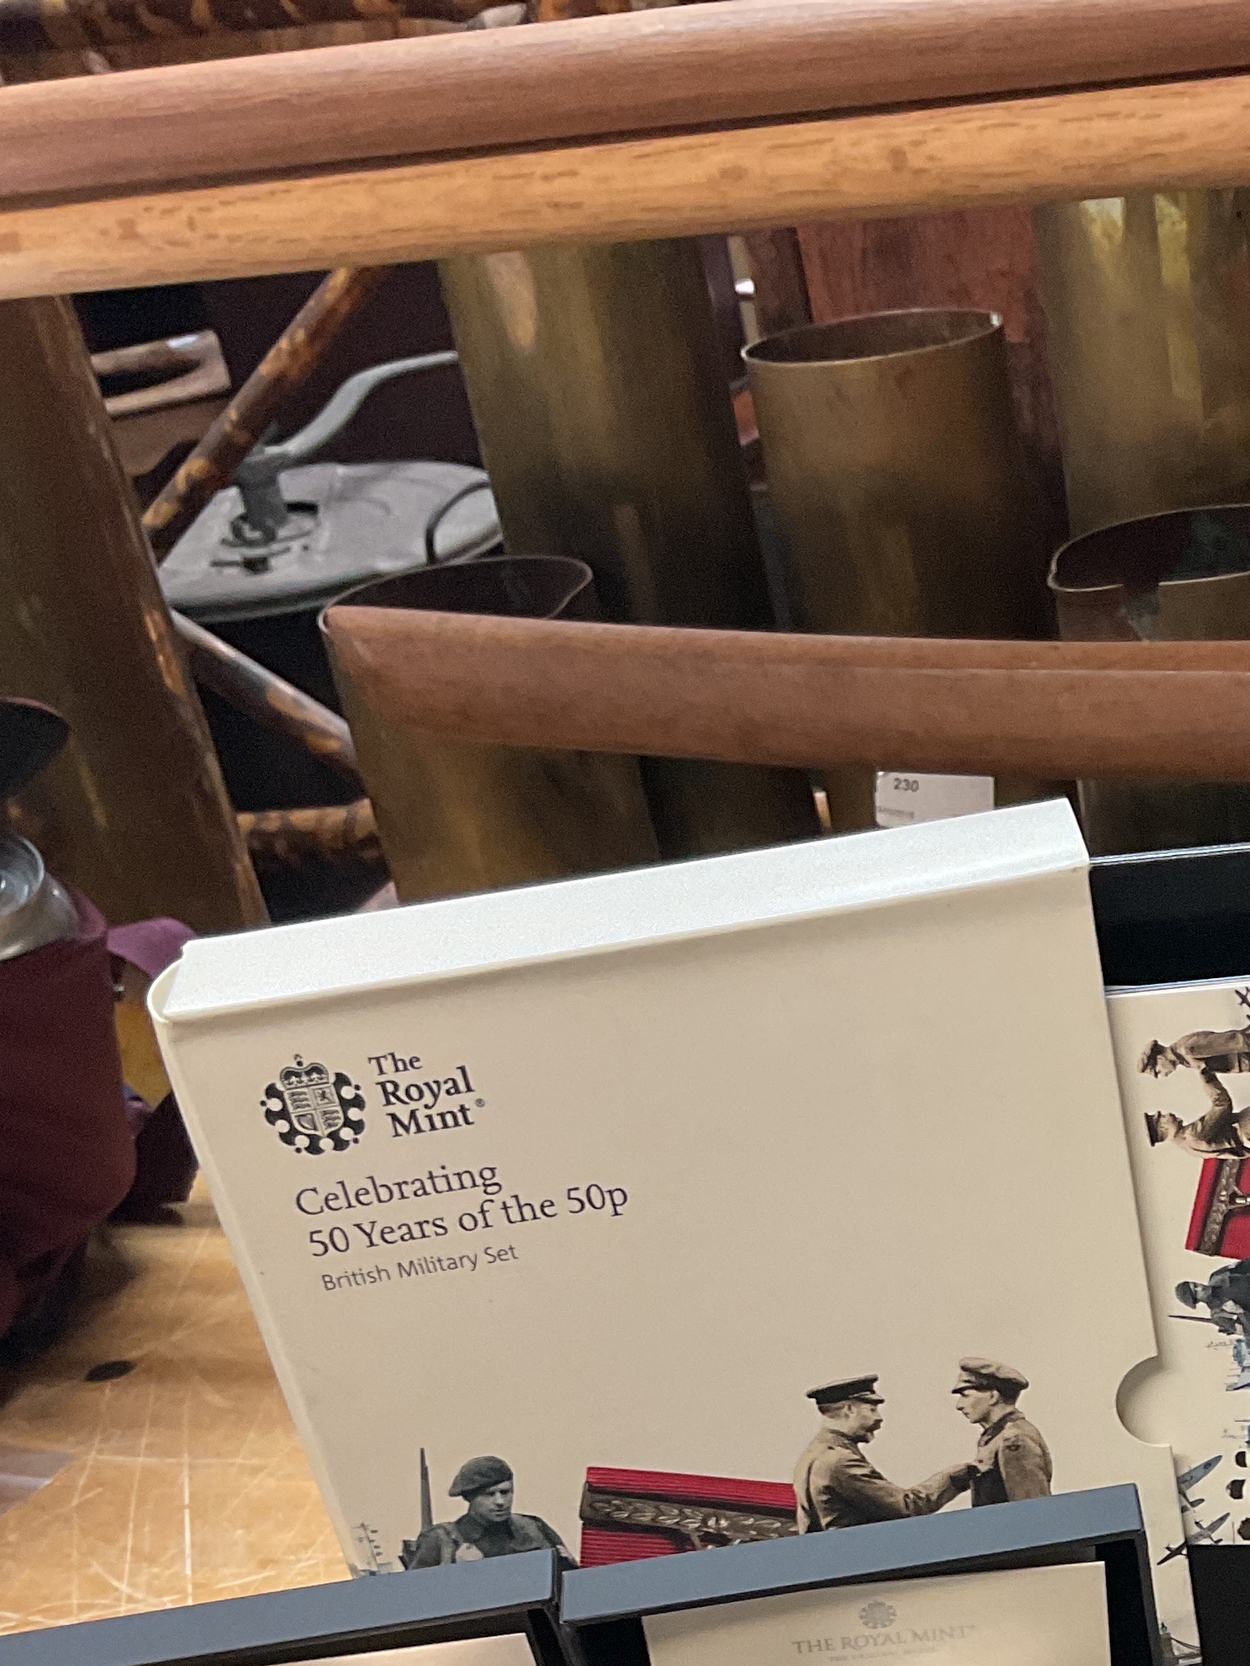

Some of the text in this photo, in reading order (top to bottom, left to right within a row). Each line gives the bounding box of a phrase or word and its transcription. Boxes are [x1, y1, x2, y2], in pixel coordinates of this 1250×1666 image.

[893, 777, 919, 793] 230
[368, 1052, 423, 1077] The
[376, 1065, 476, 1110] Royal
[296, 1163, 503, 1217] Celebrating
[309, 1183, 629, 1258] 50 Years of the 50p
[321, 1244, 520, 1292] British Military Set
[790, 1637, 837, 1655] THE
[841, 1630, 908, 1651] ROYAL
